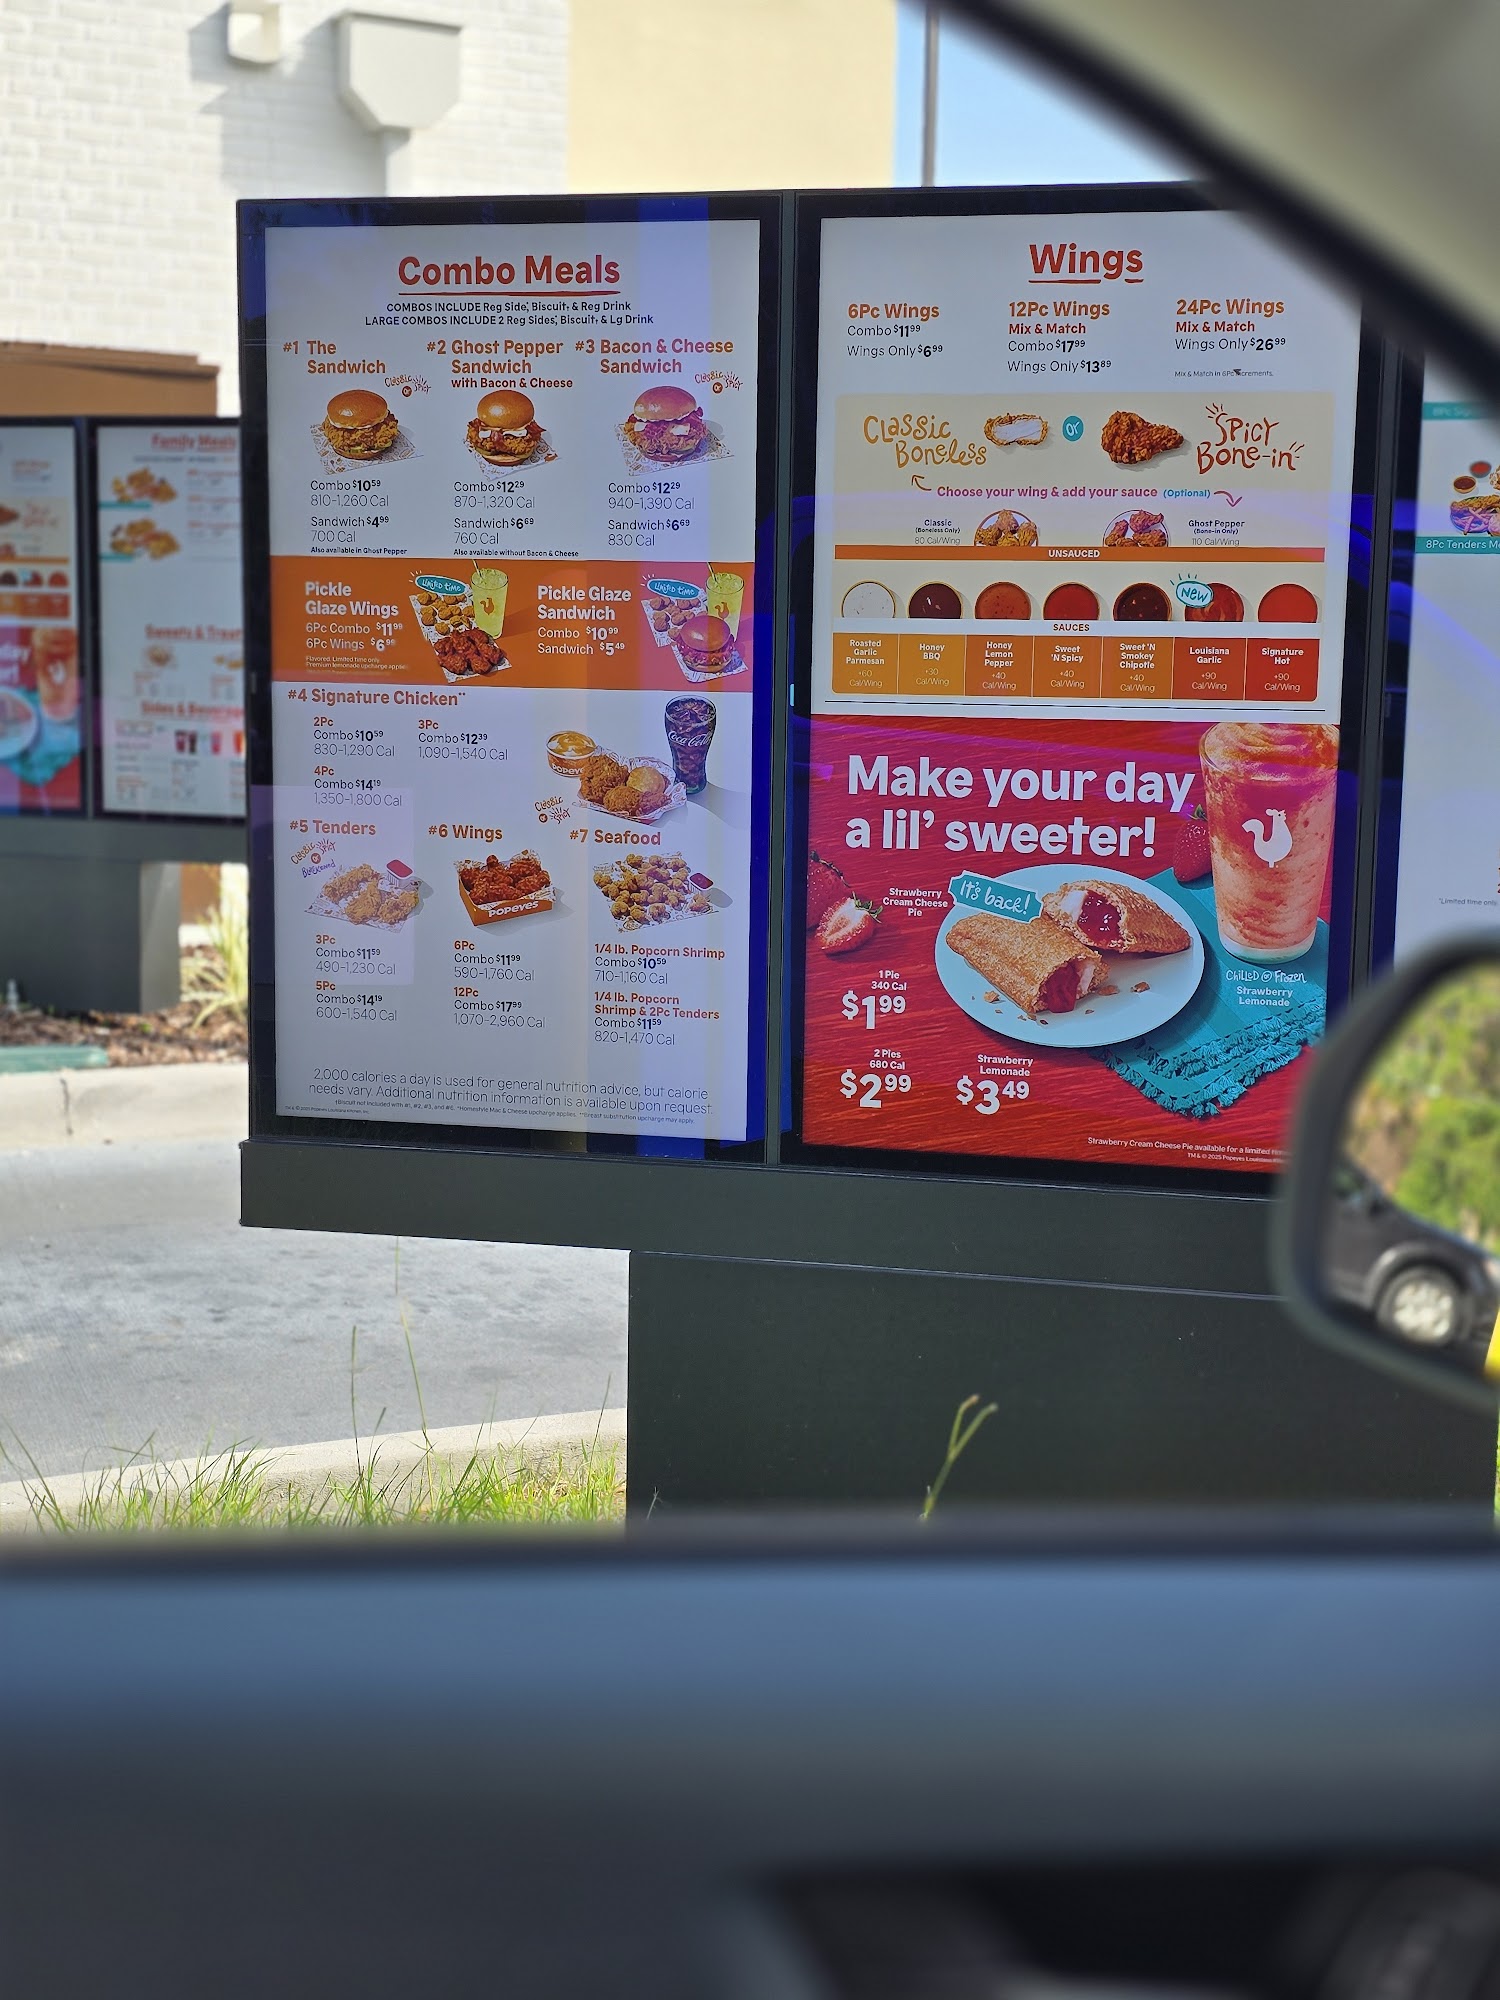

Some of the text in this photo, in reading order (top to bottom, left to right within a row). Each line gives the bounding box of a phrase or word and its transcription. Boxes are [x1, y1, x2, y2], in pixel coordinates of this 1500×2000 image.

[1029, 242, 1143, 280] Wings
[398, 255, 620, 285] Combo Meals
[387, 302, 631, 313] COMBOS INCLUDE Reg Reg Drink
[848, 303, 940, 322] 6Pc Wings
[1009, 301, 1110, 320] 12Pc Wings
[1176, 299, 1284, 318] 24Pc Wings
[365, 315, 622, 326] LARGE COMBOS INCLUDE 2 Lg
[848, 326, 891, 336] Combo
[1009, 323, 1086, 334] Mix & Match
[1176, 321, 1255, 332] Mix & Match
[283, 340, 336, 354] #1 The
[427, 340, 563, 357] #2 Ghost Pepper
[575, 338, 734, 354] #3 Bacon & Cheese
[1008, 341, 1053, 352] Combo
[1175, 338, 1248, 351] Wings Only
[848, 345, 915, 358] Wings Only
[307, 360, 386, 374] Sandwich
[452, 360, 532, 374] Sandwich
[600, 359, 682, 374] Sandwich
[451, 378, 572, 388] with Bacon & Cheese
[311, 481, 350, 490] Combo
[937, 486, 1210, 499] Choose your wing add your sauce (Optional)
[370, 495, 389, 506] Cal
[311, 516, 364, 527] Sandwich
[1214, 520, 1245, 528] Pepper
[312, 530, 356, 542] 700 Cal
[608, 534, 632, 546] 830
[927, 537, 960, 545] Cal/Wing
[1426, 540, 1486, 548] 8Pc Tenders
[1048, 550, 1100, 558] UNSAUCED
[306, 582, 351, 596] Pickle
[538, 586, 631, 601] Pickle Glaze
[350, 601, 398, 619] Wings
[538, 605, 616, 620] Sandwich
[306, 623, 327, 633] 6Pc
[1053, 624, 1090, 632] SAUCES
[850, 639, 881, 647] Roasted
[919, 644, 944, 652] Honey
[854, 648, 877, 656] Garlic
[985, 650, 1013, 658] Lemon
[1055, 645, 1080, 653] Sweet
[1190, 647, 1229, 655] Louisiana
[846, 657, 884, 665] Parmesan
[923, 652, 940, 660] BBQ
[1062, 654, 1083, 663] Spicy
[1121, 652, 1154, 660] Smokey
[984, 659, 1013, 667] Pepper
[1120, 661, 1155, 670] Chipotle
[288, 688, 390, 706] #4 Signature
[314, 717, 334, 726] 2Pc
[418, 720, 438, 729] 3Pc
[314, 766, 334, 776] 4Pc
[848, 755, 1195, 812] Make your day
[290, 820, 376, 835] #5 Tenders
[429, 824, 502, 842] #6 Wings
[570, 829, 661, 845] #7 Seafood
[846, 817, 871, 848] a
[945, 816, 1155, 858] sweeter!
[889, 888, 941, 899] Strawberry
[984, 884, 1029, 914] back!
[883, 897, 948, 908] Cream Cheese
[908, 908, 922, 917] Pie
[595, 944, 725, 959] 1/4 lb. Popcorn Shrimp
[316, 981, 335, 990] 5Pc
[871, 981, 890, 990] 340
[1237, 986, 1293, 998] Strawberry
[650, 1007, 720, 1020] 2Pc Tenders
[978, 1054, 1033, 1066] Strawberry
[980, 1066, 1030, 1076] Lemonade
[314, 1068, 708, 1099] 2,000 calories a day is used for general nutrition advice, but calorie
[1088, 1137, 1128, 1147] Strawberry
[1130, 1140, 1153, 1148] Cream
[1155, 1141, 1181, 1150] Cheese
